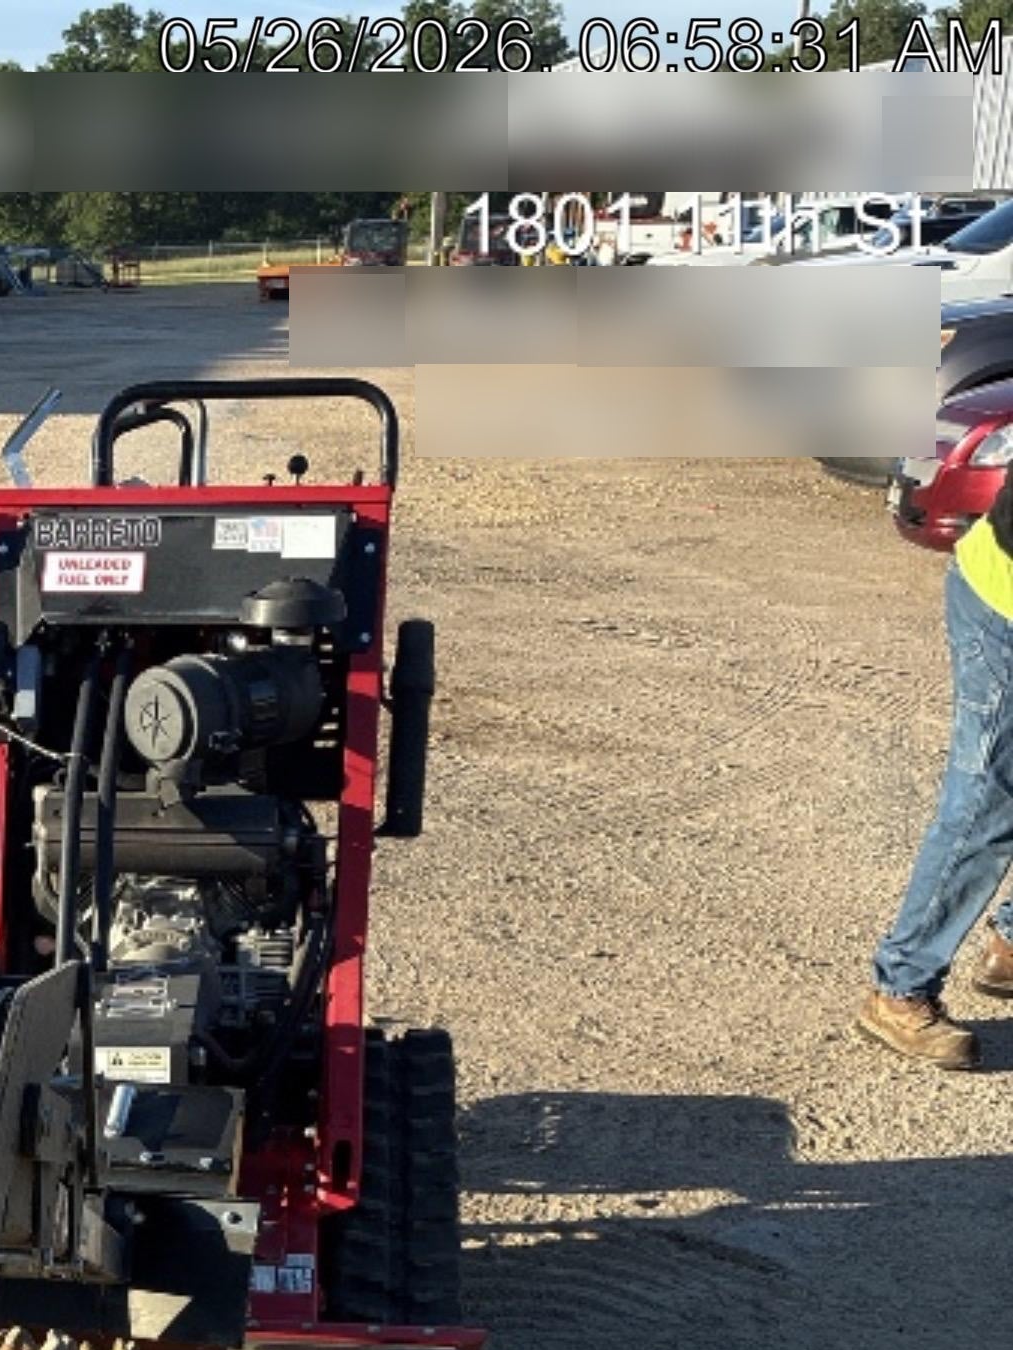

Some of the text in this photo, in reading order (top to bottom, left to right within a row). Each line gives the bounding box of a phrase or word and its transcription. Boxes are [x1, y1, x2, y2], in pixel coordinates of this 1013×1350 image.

[34, 517, 162, 549] BARRETO
[58, 558, 132, 571] UNLEADED
[57, 574, 90, 586] FUEL
